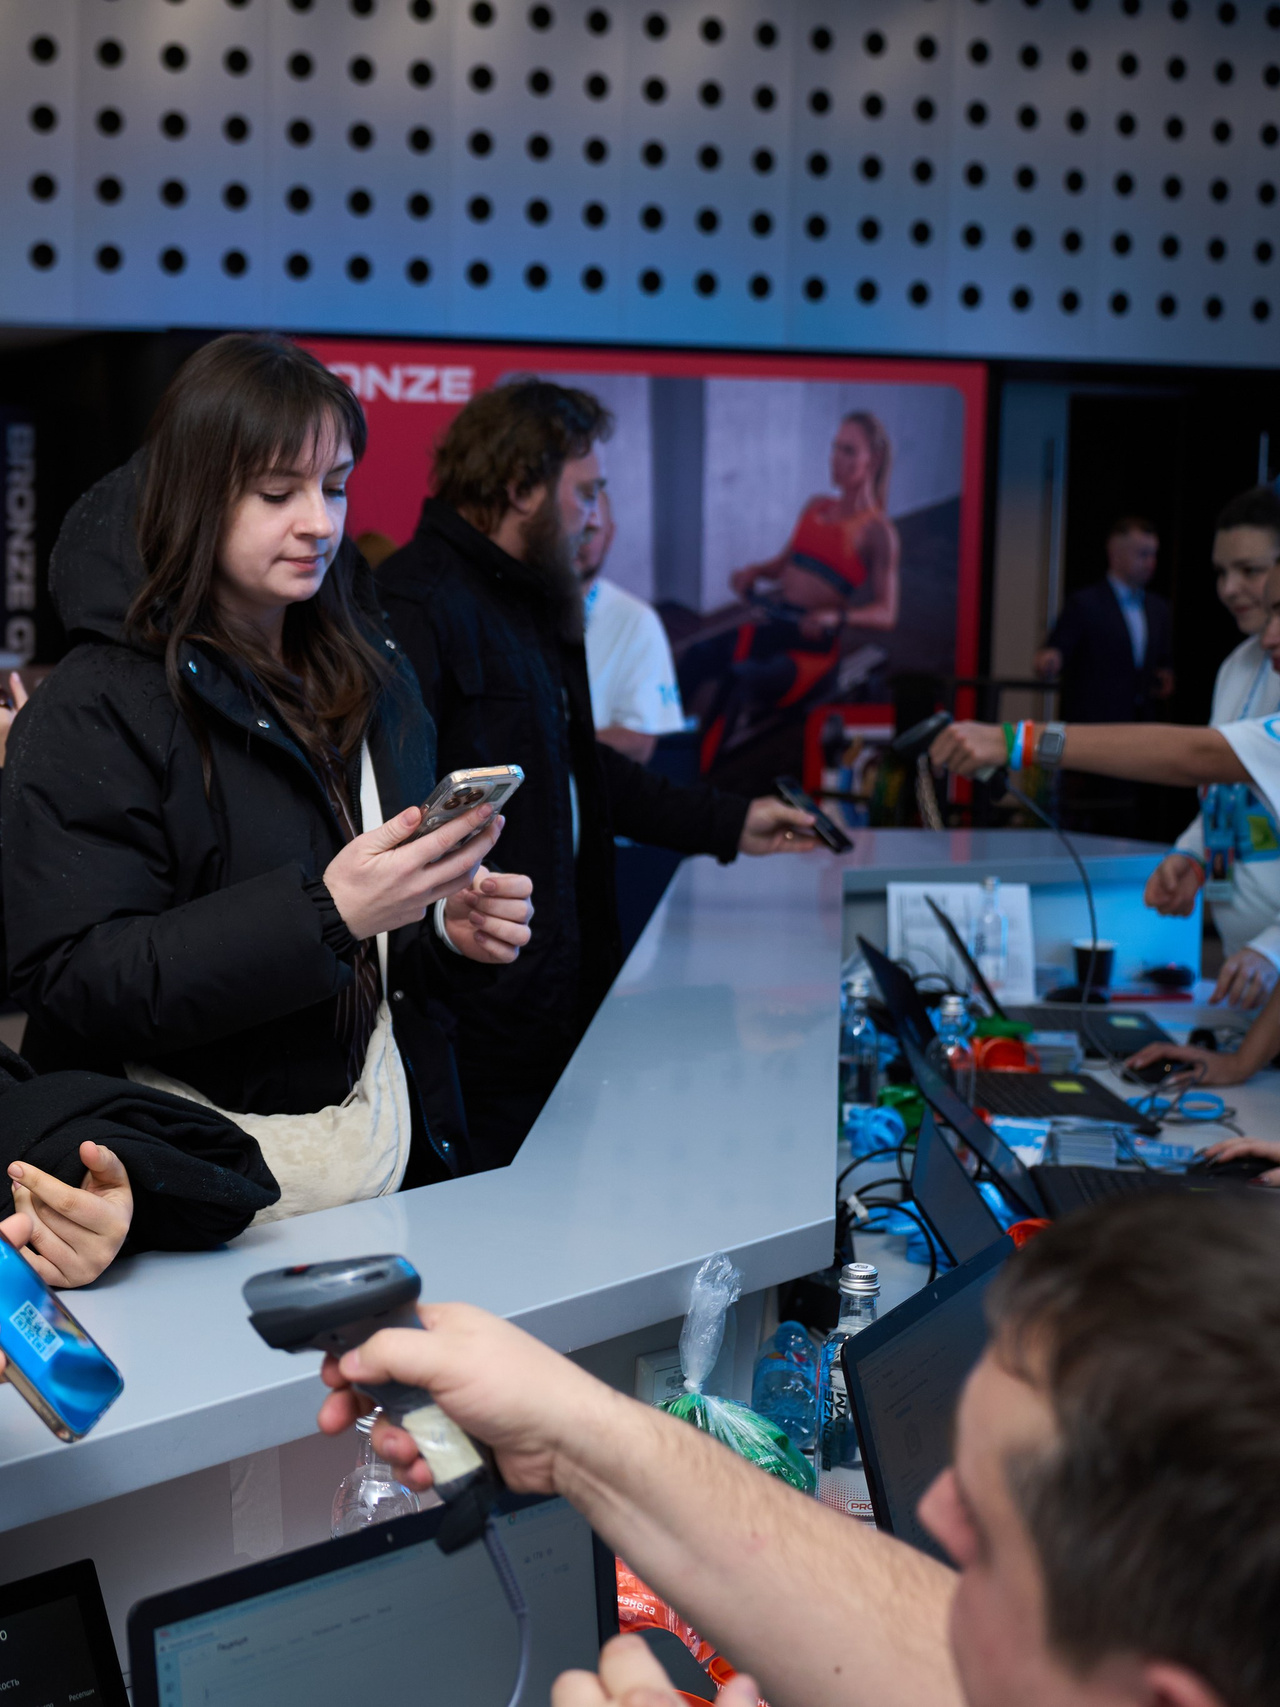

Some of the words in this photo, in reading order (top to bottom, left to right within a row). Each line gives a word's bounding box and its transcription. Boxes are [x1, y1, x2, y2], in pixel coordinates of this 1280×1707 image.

[6, 422, 36, 612] BRONZE
[822, 1389, 834, 1472] BRONZE
[835, 1393, 847, 1434] GYM
